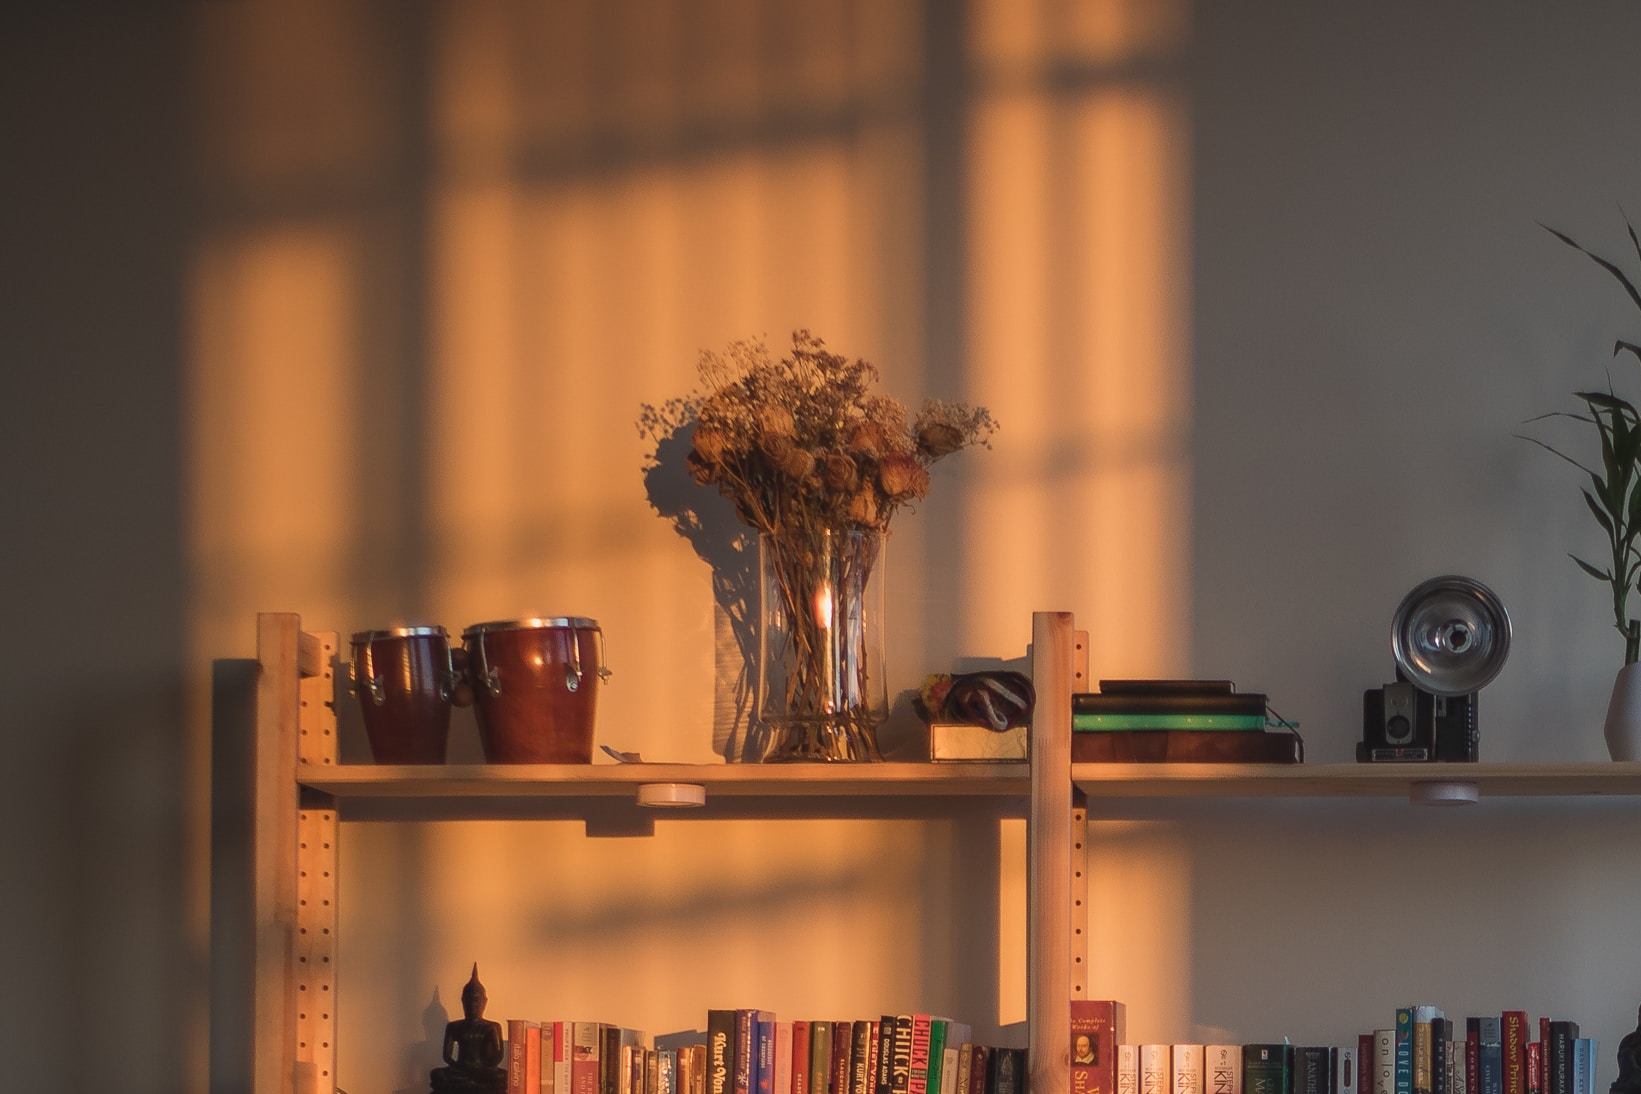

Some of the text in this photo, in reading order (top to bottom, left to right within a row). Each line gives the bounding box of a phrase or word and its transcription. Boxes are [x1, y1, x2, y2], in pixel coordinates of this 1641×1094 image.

[714, 1032, 726, 1066] Kurt
[913, 1020, 930, 1067] CHUCK
[1382, 1038, 1389, 1055] on
[1509, 1016, 1519, 1061] Shadow
[1398, 1042, 1408, 1074] LOVE
[881, 1066, 889, 1085] ADAMS
